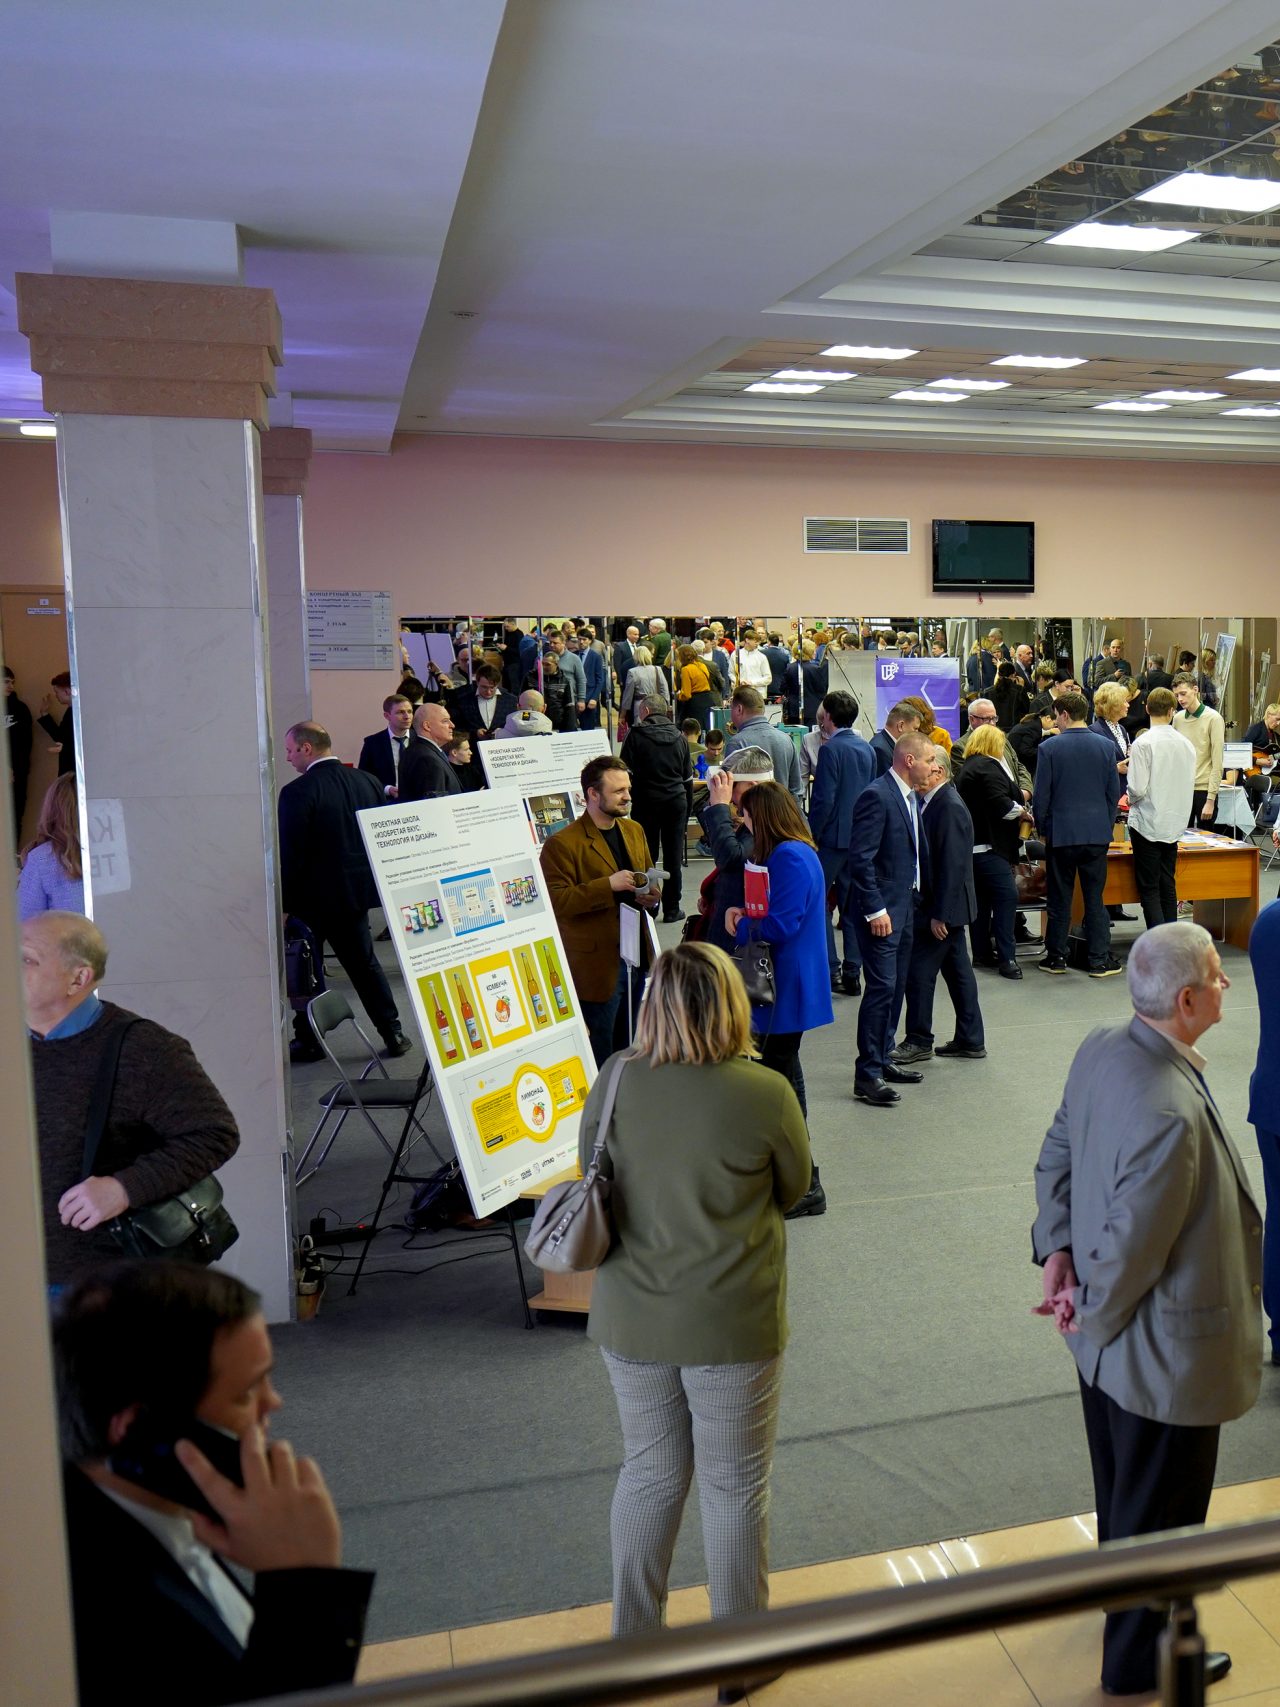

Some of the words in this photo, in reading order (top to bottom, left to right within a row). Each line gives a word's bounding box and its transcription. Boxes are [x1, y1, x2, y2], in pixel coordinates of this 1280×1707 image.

[370, 818, 402, 830] ПРОЕКТНАЯ
[401, 815, 420, 825] ШКОЛА
[374, 827, 407, 839] «ИЗОБРЕТАЯ
[376, 836, 411, 849] ТЕХНОЛОГИЯ
[414, 831, 438, 842] ДИЗАЙН»
[486, 979, 508, 991] КОМБУЧА
[520, 1086, 544, 1101] ЛИМОНАД
